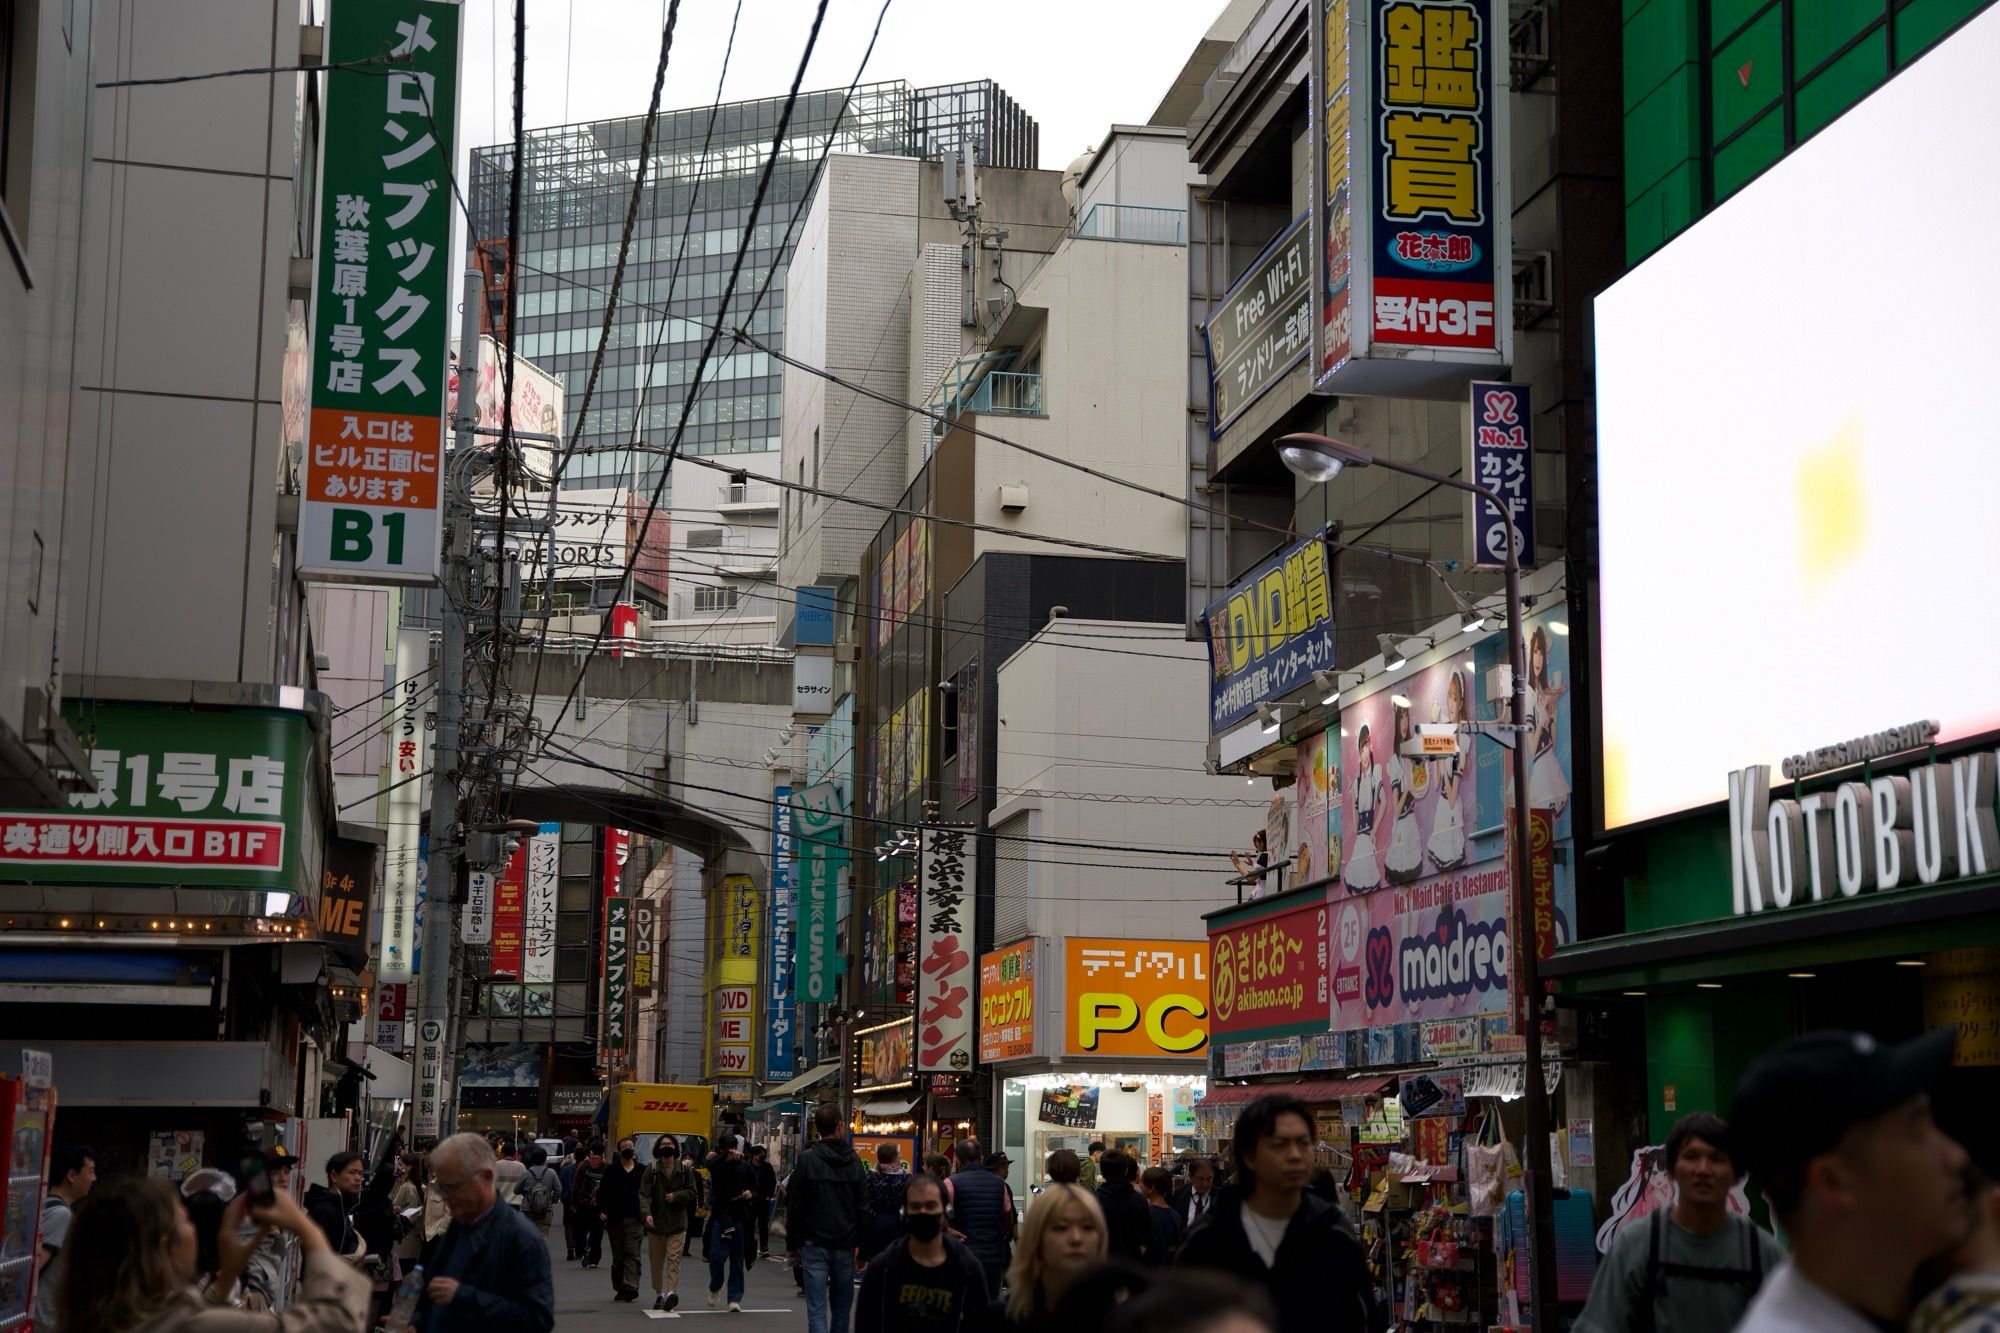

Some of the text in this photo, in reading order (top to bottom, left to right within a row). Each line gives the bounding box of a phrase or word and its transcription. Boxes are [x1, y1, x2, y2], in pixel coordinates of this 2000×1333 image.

[1383, 2, 1480, 224] 鑑賞
[370, 14, 437, 398] メロンブックス
[1396, 233, 1473, 262] 花太郎
[327, 194, 371, 394] 秋葉原1号店
[1235, 242, 1304, 338] Free Wi-Fi
[1375, 295, 1492, 338] 受付3F
[1238, 300, 1309, 397] ランドリー完備
[340, 416, 414, 442] 入口は
[1480, 426, 1527, 448] No.1
[314, 445, 435, 474] ビル正面に
[324, 476, 418, 503] あります。
[1504, 453, 1527, 520] メイド
[330, 510, 404, 564] B1
[524, 546, 614, 565] RESORTS
[798, 610, 833, 621] 内田ビル
[1228, 533, 1331, 676] DVD鑑賞
[796, 685, 832, 694] セラサイン
[1782, 719, 1940, 779] CRAFTSMANSHIP
[0, 824, 267, 858] 央通り側入口 B1F
[1728, 750, 2000, 915] KOTOBUK
[471, 886, 484, 925] 千石電商
[540, 843, 556, 957] ライブレストラン
[926, 831, 967, 934] 横浜家系
[1394, 893, 1411, 916] No.1
[1412, 888, 1432, 912] Maid
[1433, 882, 1453, 905] Cafe
[1454, 884, 1461, 899] &
[633, 908, 652, 988] DVD買取
[740, 885, 753, 955] トレーダー2
[808, 845, 826, 999] TSUKUMO
[1344, 920, 1358, 949] 2F
[607, 907, 627, 1039] メロンブックス
[1082, 949, 1207, 979] デジタル
[1216, 943, 1233, 1009] あ
[1237, 922, 1304, 984] きばお～
[1317, 910, 1327, 1003] 2号店
[1237, 979, 1304, 1013] akibaoo.co.jp
[1336, 974, 1359, 994] ENTRANCE
[1079, 992, 1209, 1053] PC
[420, 1046, 437, 1116] 福山歯科
[643, 1100, 688, 1112] DHL
